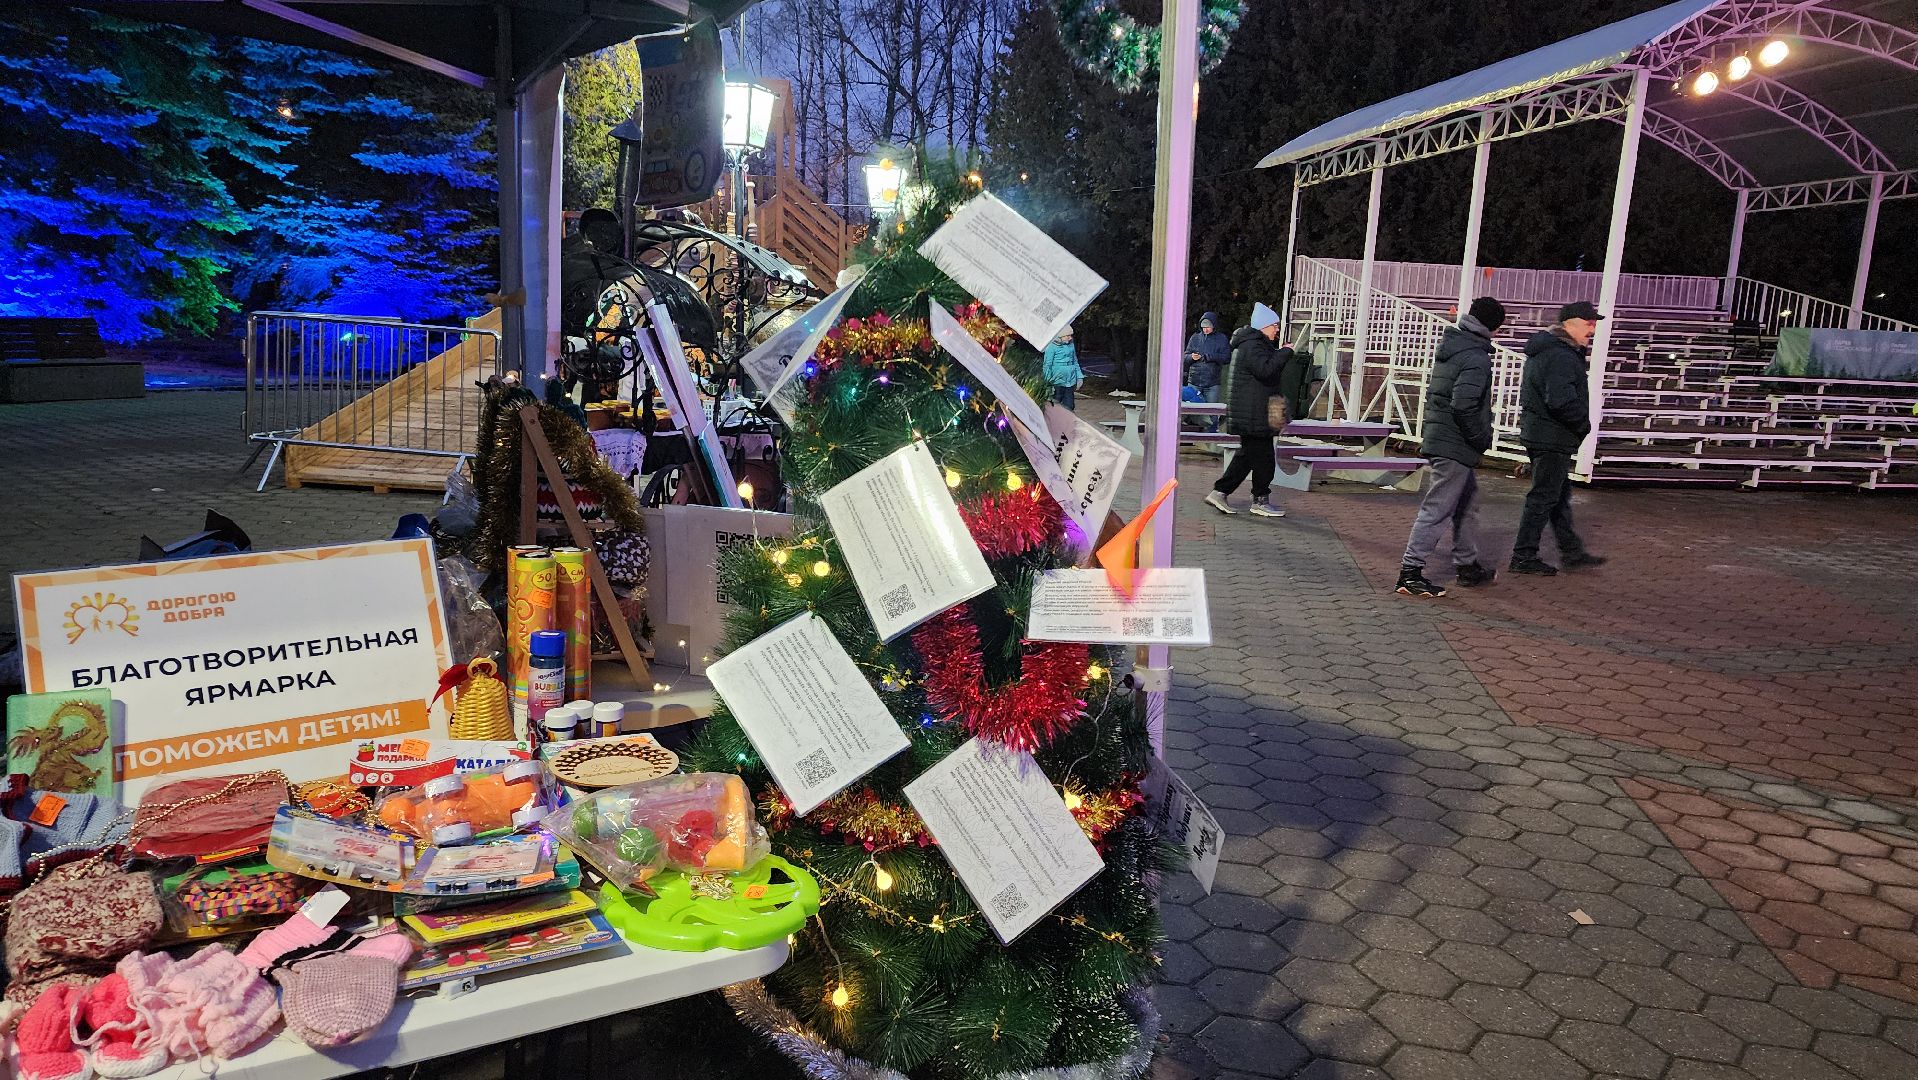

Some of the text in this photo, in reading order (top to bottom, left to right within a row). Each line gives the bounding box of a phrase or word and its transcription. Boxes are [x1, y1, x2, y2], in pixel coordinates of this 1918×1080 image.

[1081, 468, 1103, 516] орозу
[146, 591, 236, 612] ДОРОГОЮ
[163, 606, 225, 623] ДОБРА
[71, 627, 419, 688] БЛАГОТВОРИТЕЛЬНАЯ
[185, 669, 336, 706] ЯРМАРКА
[115, 708, 402, 772] ПОМОЖЕМ ДЕТЯМ!
